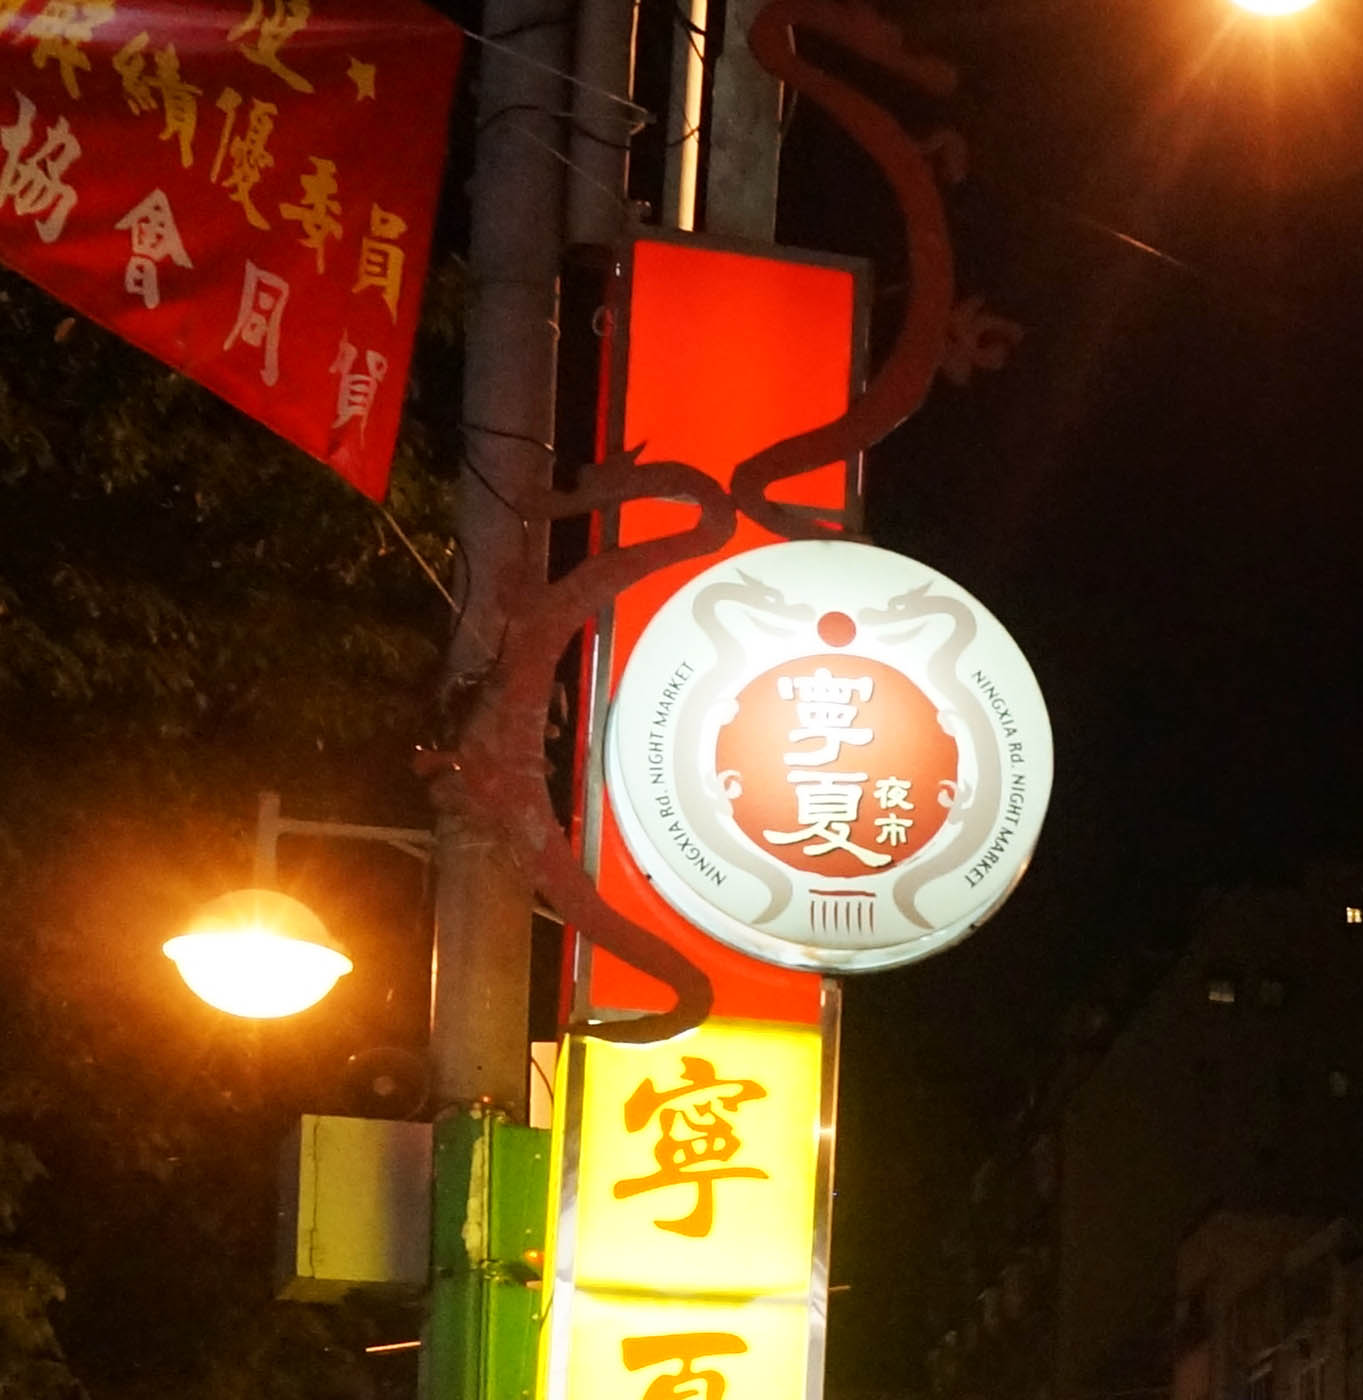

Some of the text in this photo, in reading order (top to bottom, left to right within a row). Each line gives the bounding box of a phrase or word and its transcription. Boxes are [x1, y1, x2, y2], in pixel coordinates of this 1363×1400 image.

[648, 659, 726, 888] NINGXIA Rd. NIGHT MARKET
[763, 668, 892, 868] 寧夏
[874, 776, 914, 846] 夜市
[966, 669, 1027, 889] NINGXIA Rd. NIGHT MARKET
